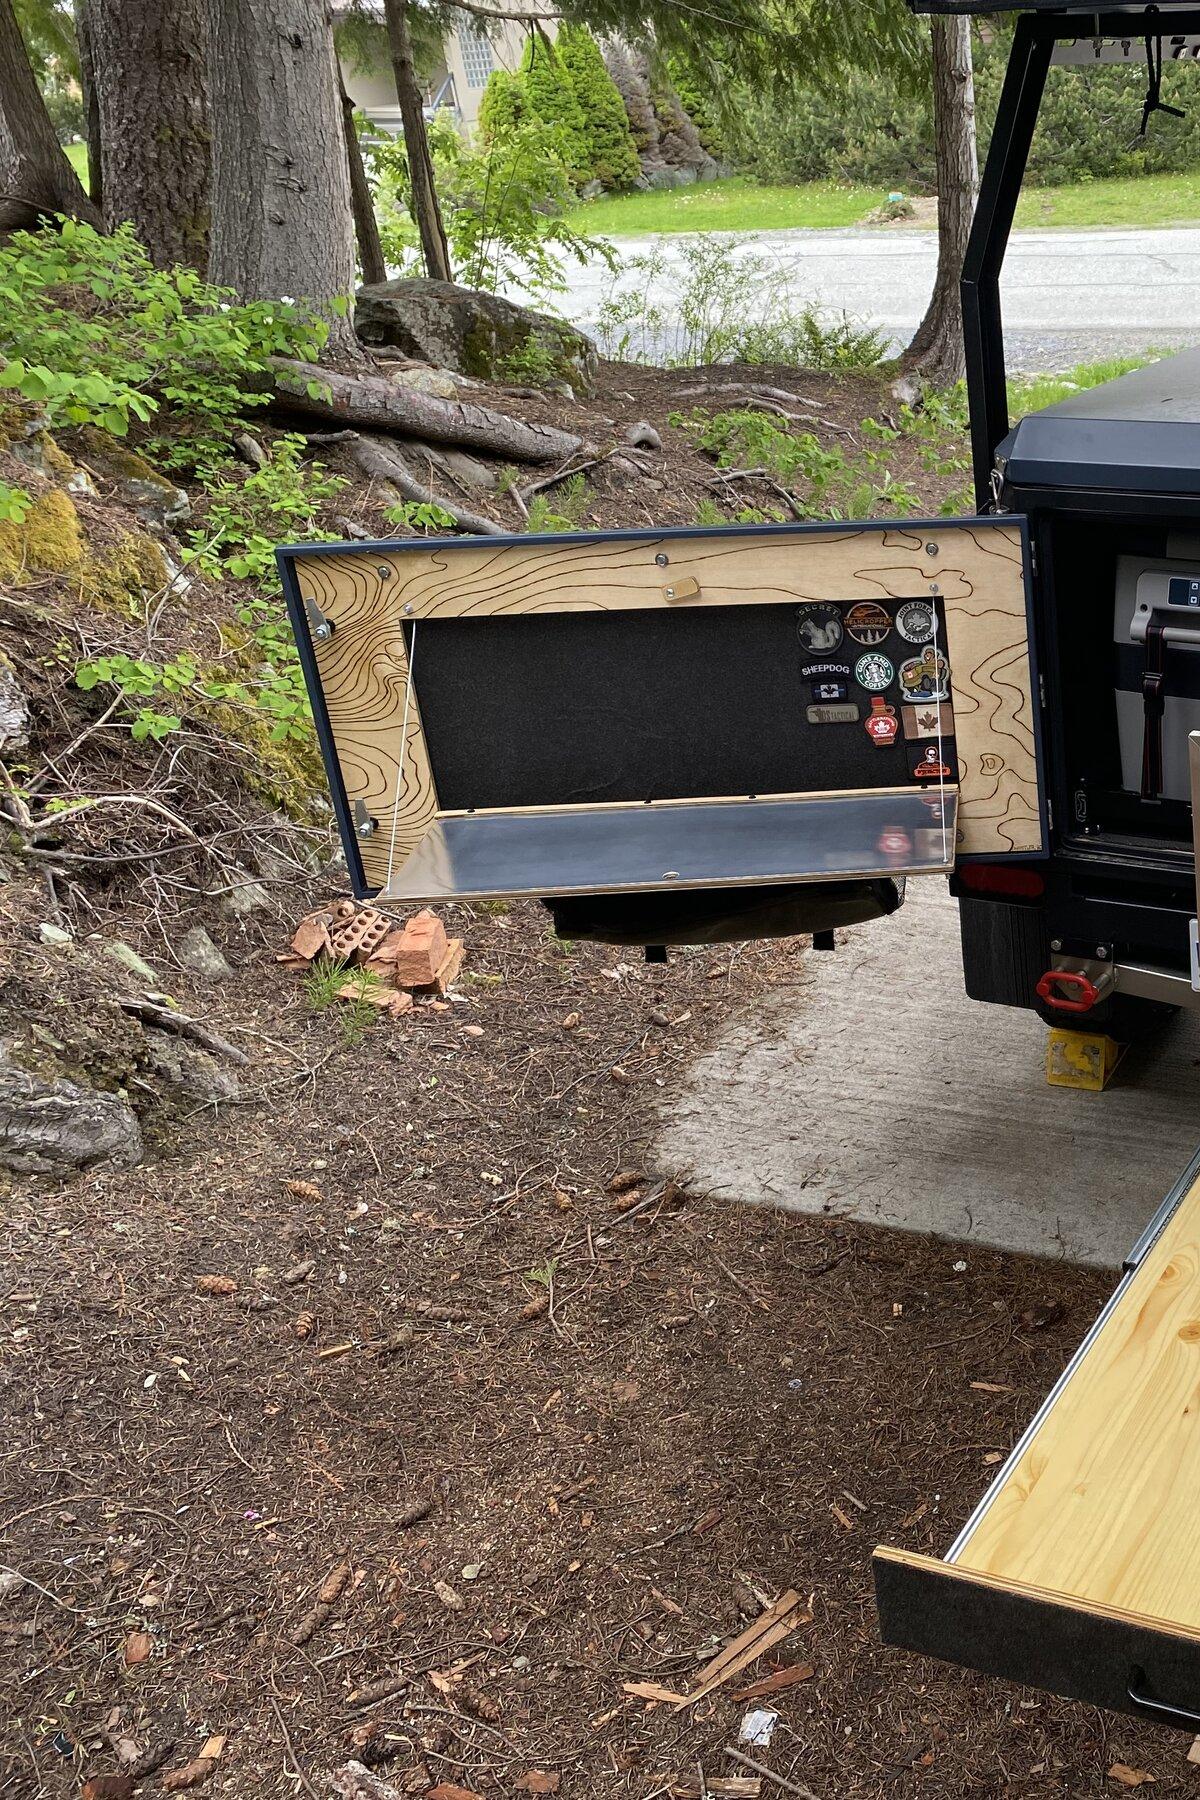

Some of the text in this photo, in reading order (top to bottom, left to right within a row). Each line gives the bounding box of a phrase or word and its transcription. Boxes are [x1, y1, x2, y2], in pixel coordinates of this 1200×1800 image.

[798, 604, 839, 616] SECRET
[897, 602, 934, 619] JOINT FORCE
[905, 631, 935, 643] TACTICAL
[801, 664, 850, 676] SHEEPDOG
[858, 656, 889, 673] GUNS AND
[864, 678, 890, 689] COFFEE
